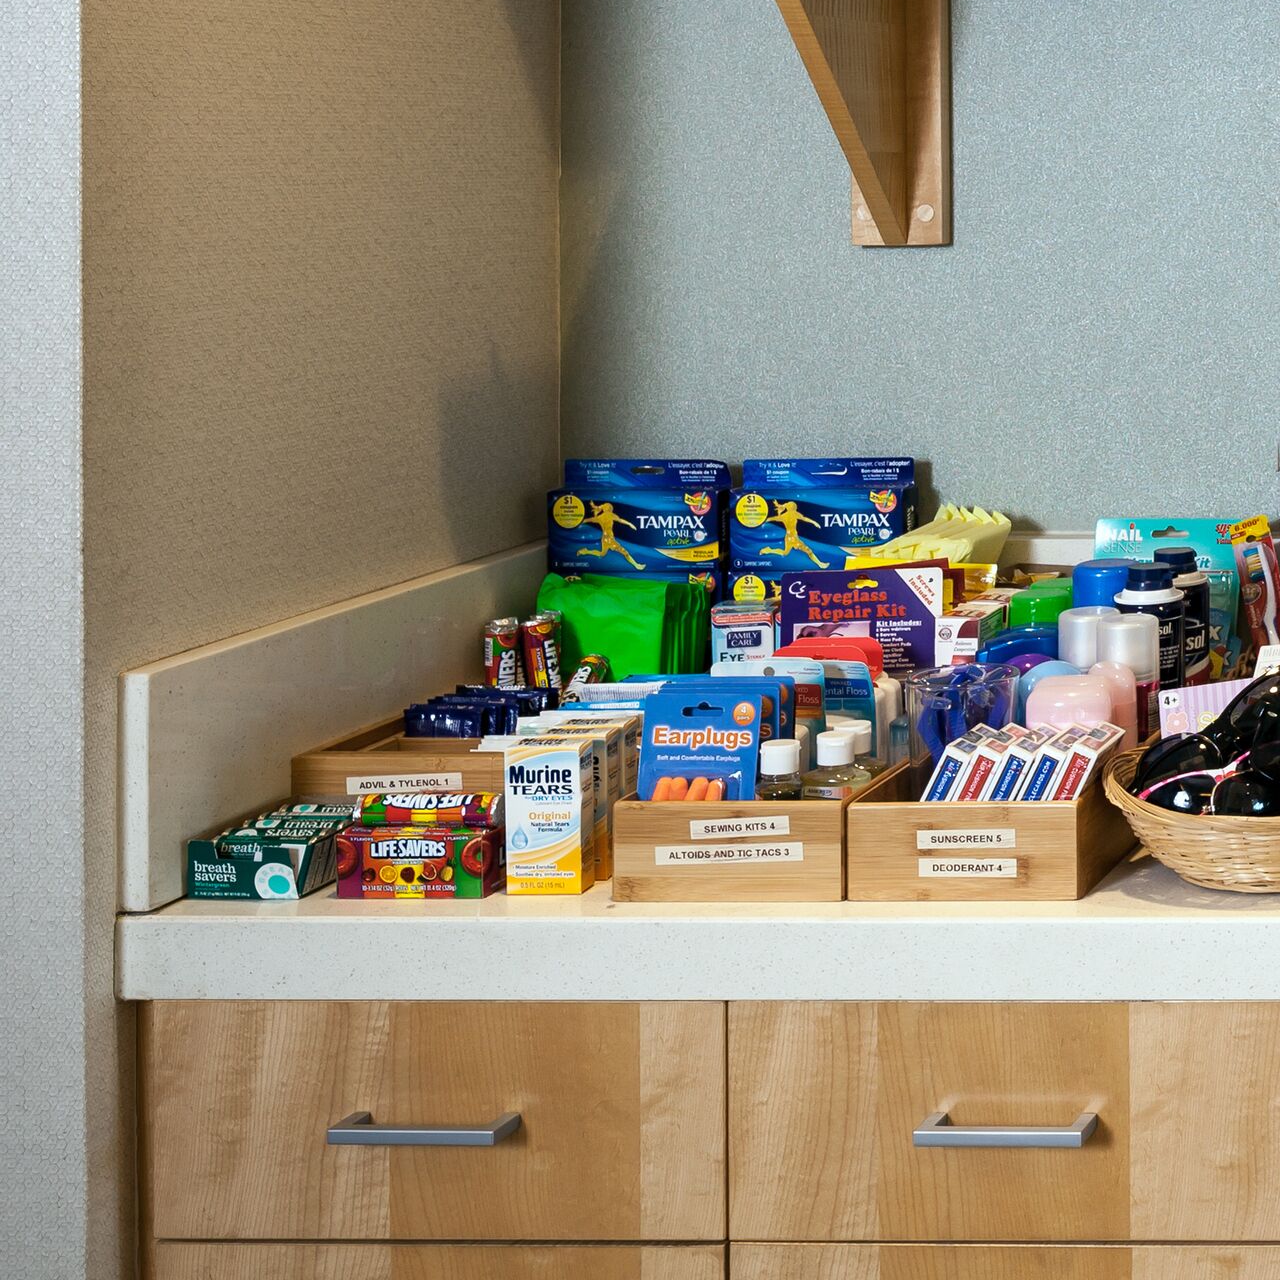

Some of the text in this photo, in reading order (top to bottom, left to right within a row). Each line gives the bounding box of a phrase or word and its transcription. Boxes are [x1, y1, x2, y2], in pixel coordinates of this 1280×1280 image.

[563, 496, 573, 505] $1
[746, 495, 757, 505] $1
[636, 515, 705, 529] TAMPAX
[820, 514, 890, 527] TAMPAX
[663, 529, 692, 538] PEARL
[848, 528, 876, 536] PEARL
[1103, 542, 1143, 554] SENSE
[744, 576, 754, 585] $1
[915, 574, 936, 597] Screws
[808, 588, 888, 605] Eyeglass
[908, 577, 934, 606] Included
[808, 603, 907, 622] Repair Kit
[728, 632, 760, 640] FAMILY
[846, 685, 868, 696] Floss
[798, 694, 820, 704] Floss
[1164, 696, 1178, 706] 4+
[739, 705, 748, 714] 4
[652, 726, 753, 750] Earplugs
[716, 754, 741, 762] Earplugs
[509, 765, 572, 784] Murine
[359, 781, 387, 789] ADVIL
[389, 780, 396, 788] &
[399, 779, 442, 787] TYLENOL
[510, 785, 573, 795] TEARS
[528, 811, 571, 823] Original
[265, 828, 315, 837] savers
[704, 822, 776, 834] SEWING KITS 4
[930, 834, 1003, 844] SUNSCREEN 5
[220, 842, 262, 853] breath
[668, 847, 790, 860] ALTOIDS AND TIC TACS 3
[194, 860, 236, 873] breath
[932, 863, 1003, 872] DEODERANT 4
[194, 872, 237, 883] savers
